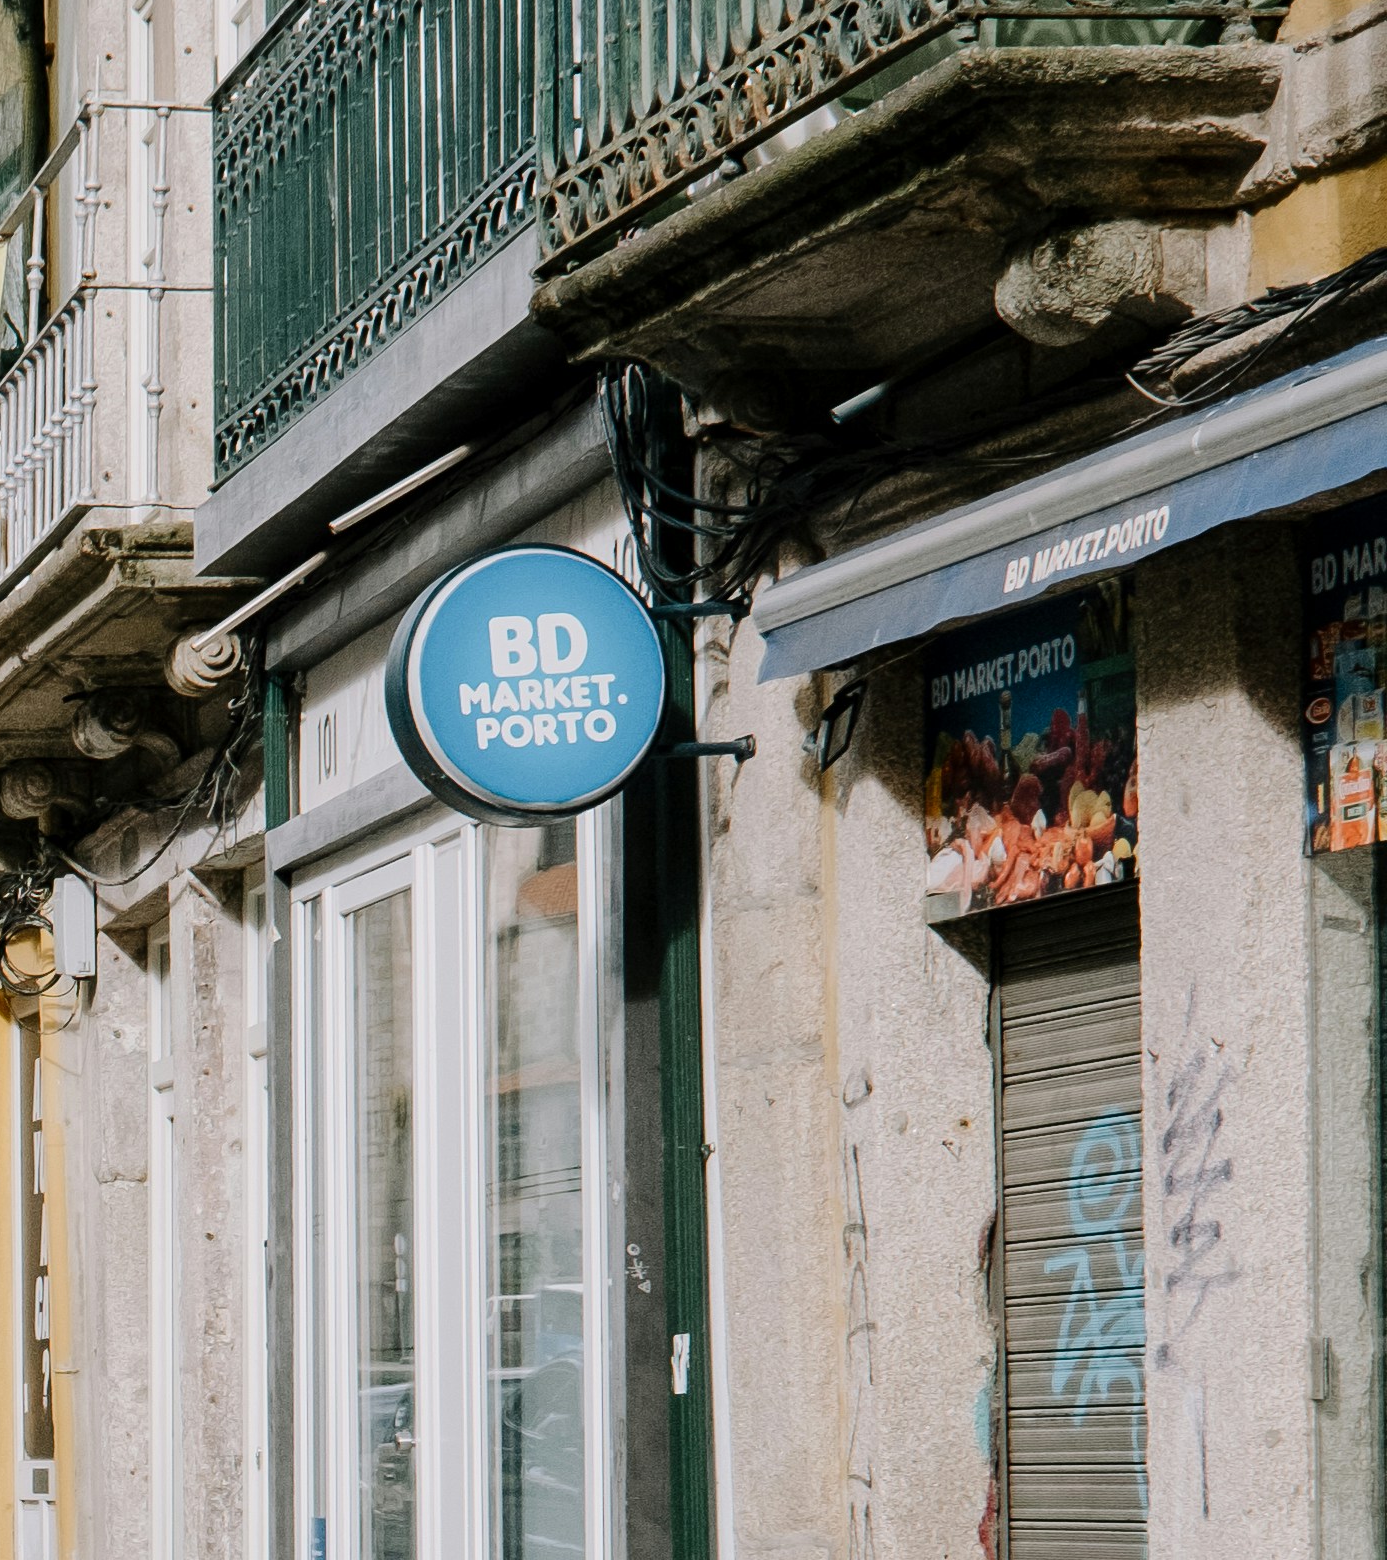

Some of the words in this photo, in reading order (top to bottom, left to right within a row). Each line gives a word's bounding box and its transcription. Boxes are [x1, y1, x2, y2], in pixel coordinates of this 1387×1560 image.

[1003, 555, 1030, 593] BD
[1311, 553, 1337, 595] BD
[487, 612, 588, 678] BD
[931, 674, 951, 710] BD
[954, 634, 1075, 702] MARKET.PORTO
[459, 673, 628, 716] MARKET.
[476, 708, 617, 750] PORTO
